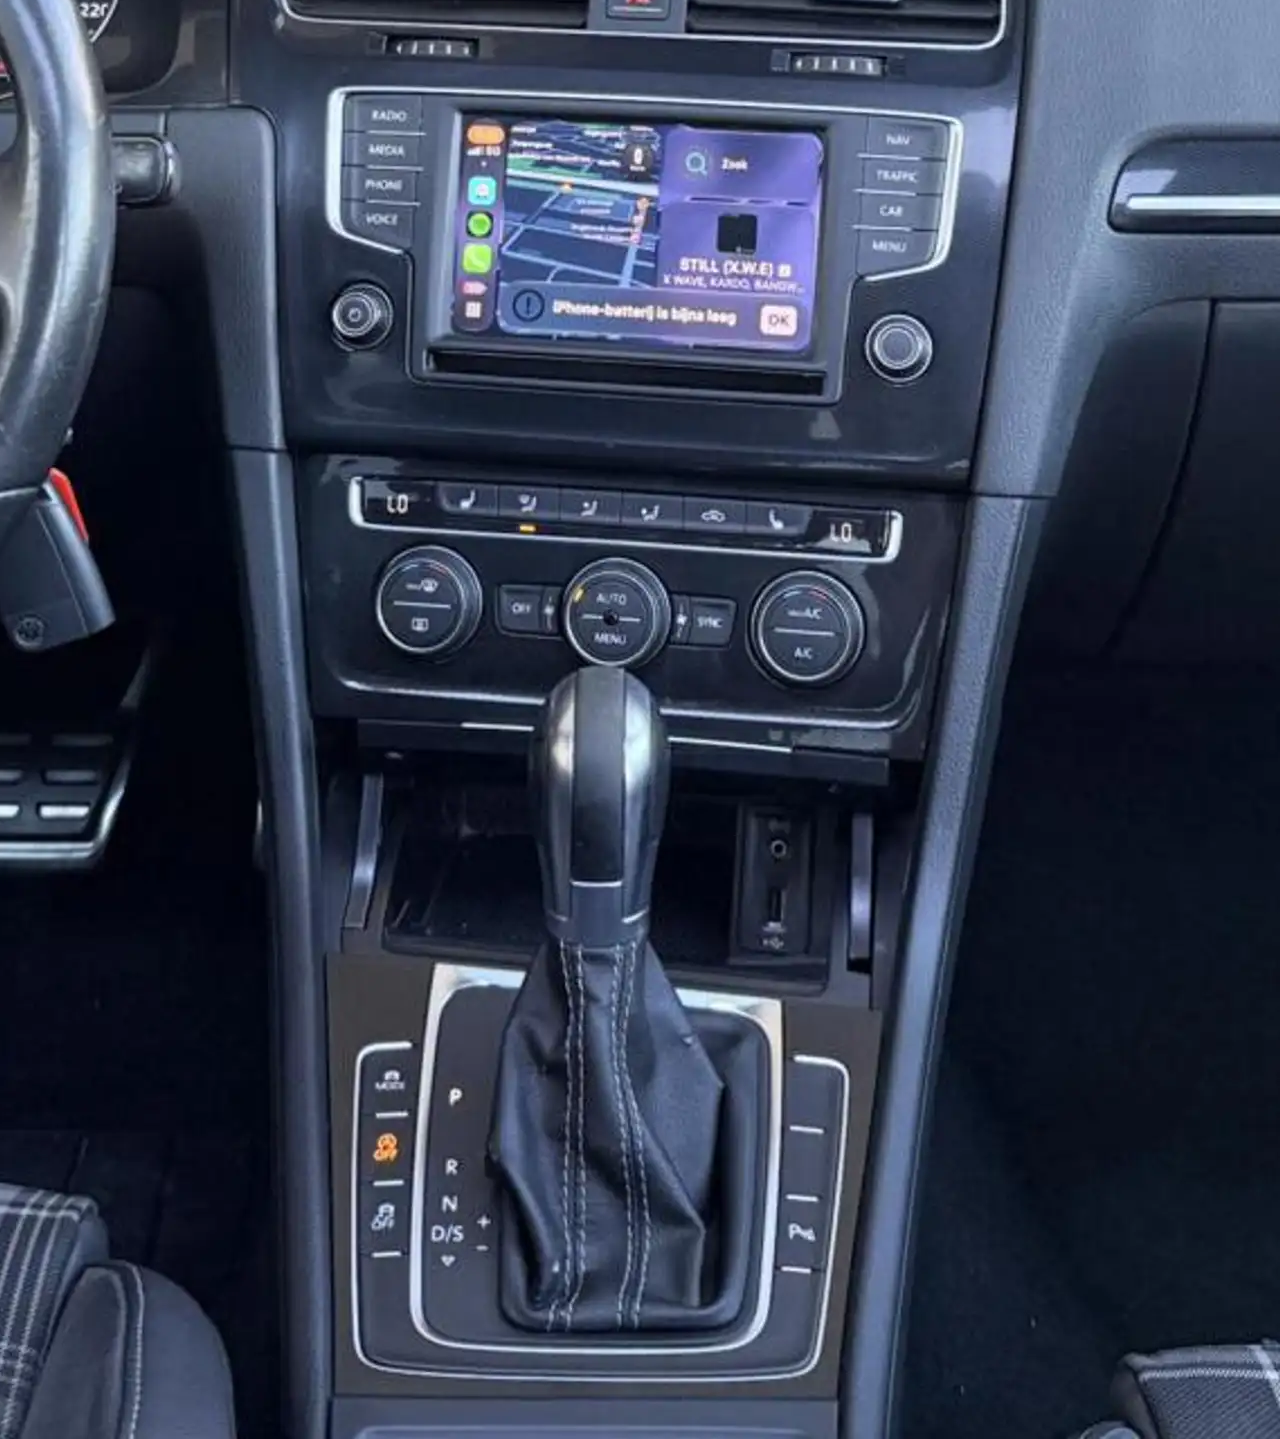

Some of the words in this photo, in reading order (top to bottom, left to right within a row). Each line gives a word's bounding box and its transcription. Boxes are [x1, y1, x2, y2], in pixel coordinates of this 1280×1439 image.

[371, 109, 408, 122] RADIO
[367, 143, 405, 157] MEDIA
[364, 179, 403, 191] PHONE
[365, 212, 399, 226] VOICE
[872, 239, 907, 253] MENU
[679, 257, 720, 274] STILL
[552, 299, 654, 323] iPhone-batterij
[671, 305, 704, 324] bijna
[706, 308, 738, 328] leeg
[768, 313, 790, 328] OK
[386, 493, 409, 514] LO
[830, 522, 853, 543] LO
[595, 592, 627, 606] AUTO
[511, 603, 531, 615] OFF
[696, 617, 724, 629] SYNC
[594, 631, 627, 645] MENU
[793, 646, 813, 660] A/C
[448, 1087, 463, 1107] P
[445, 1158, 459, 1176] R
[441, 1195, 459, 1212] N
[431, 1224, 465, 1244] D/S
